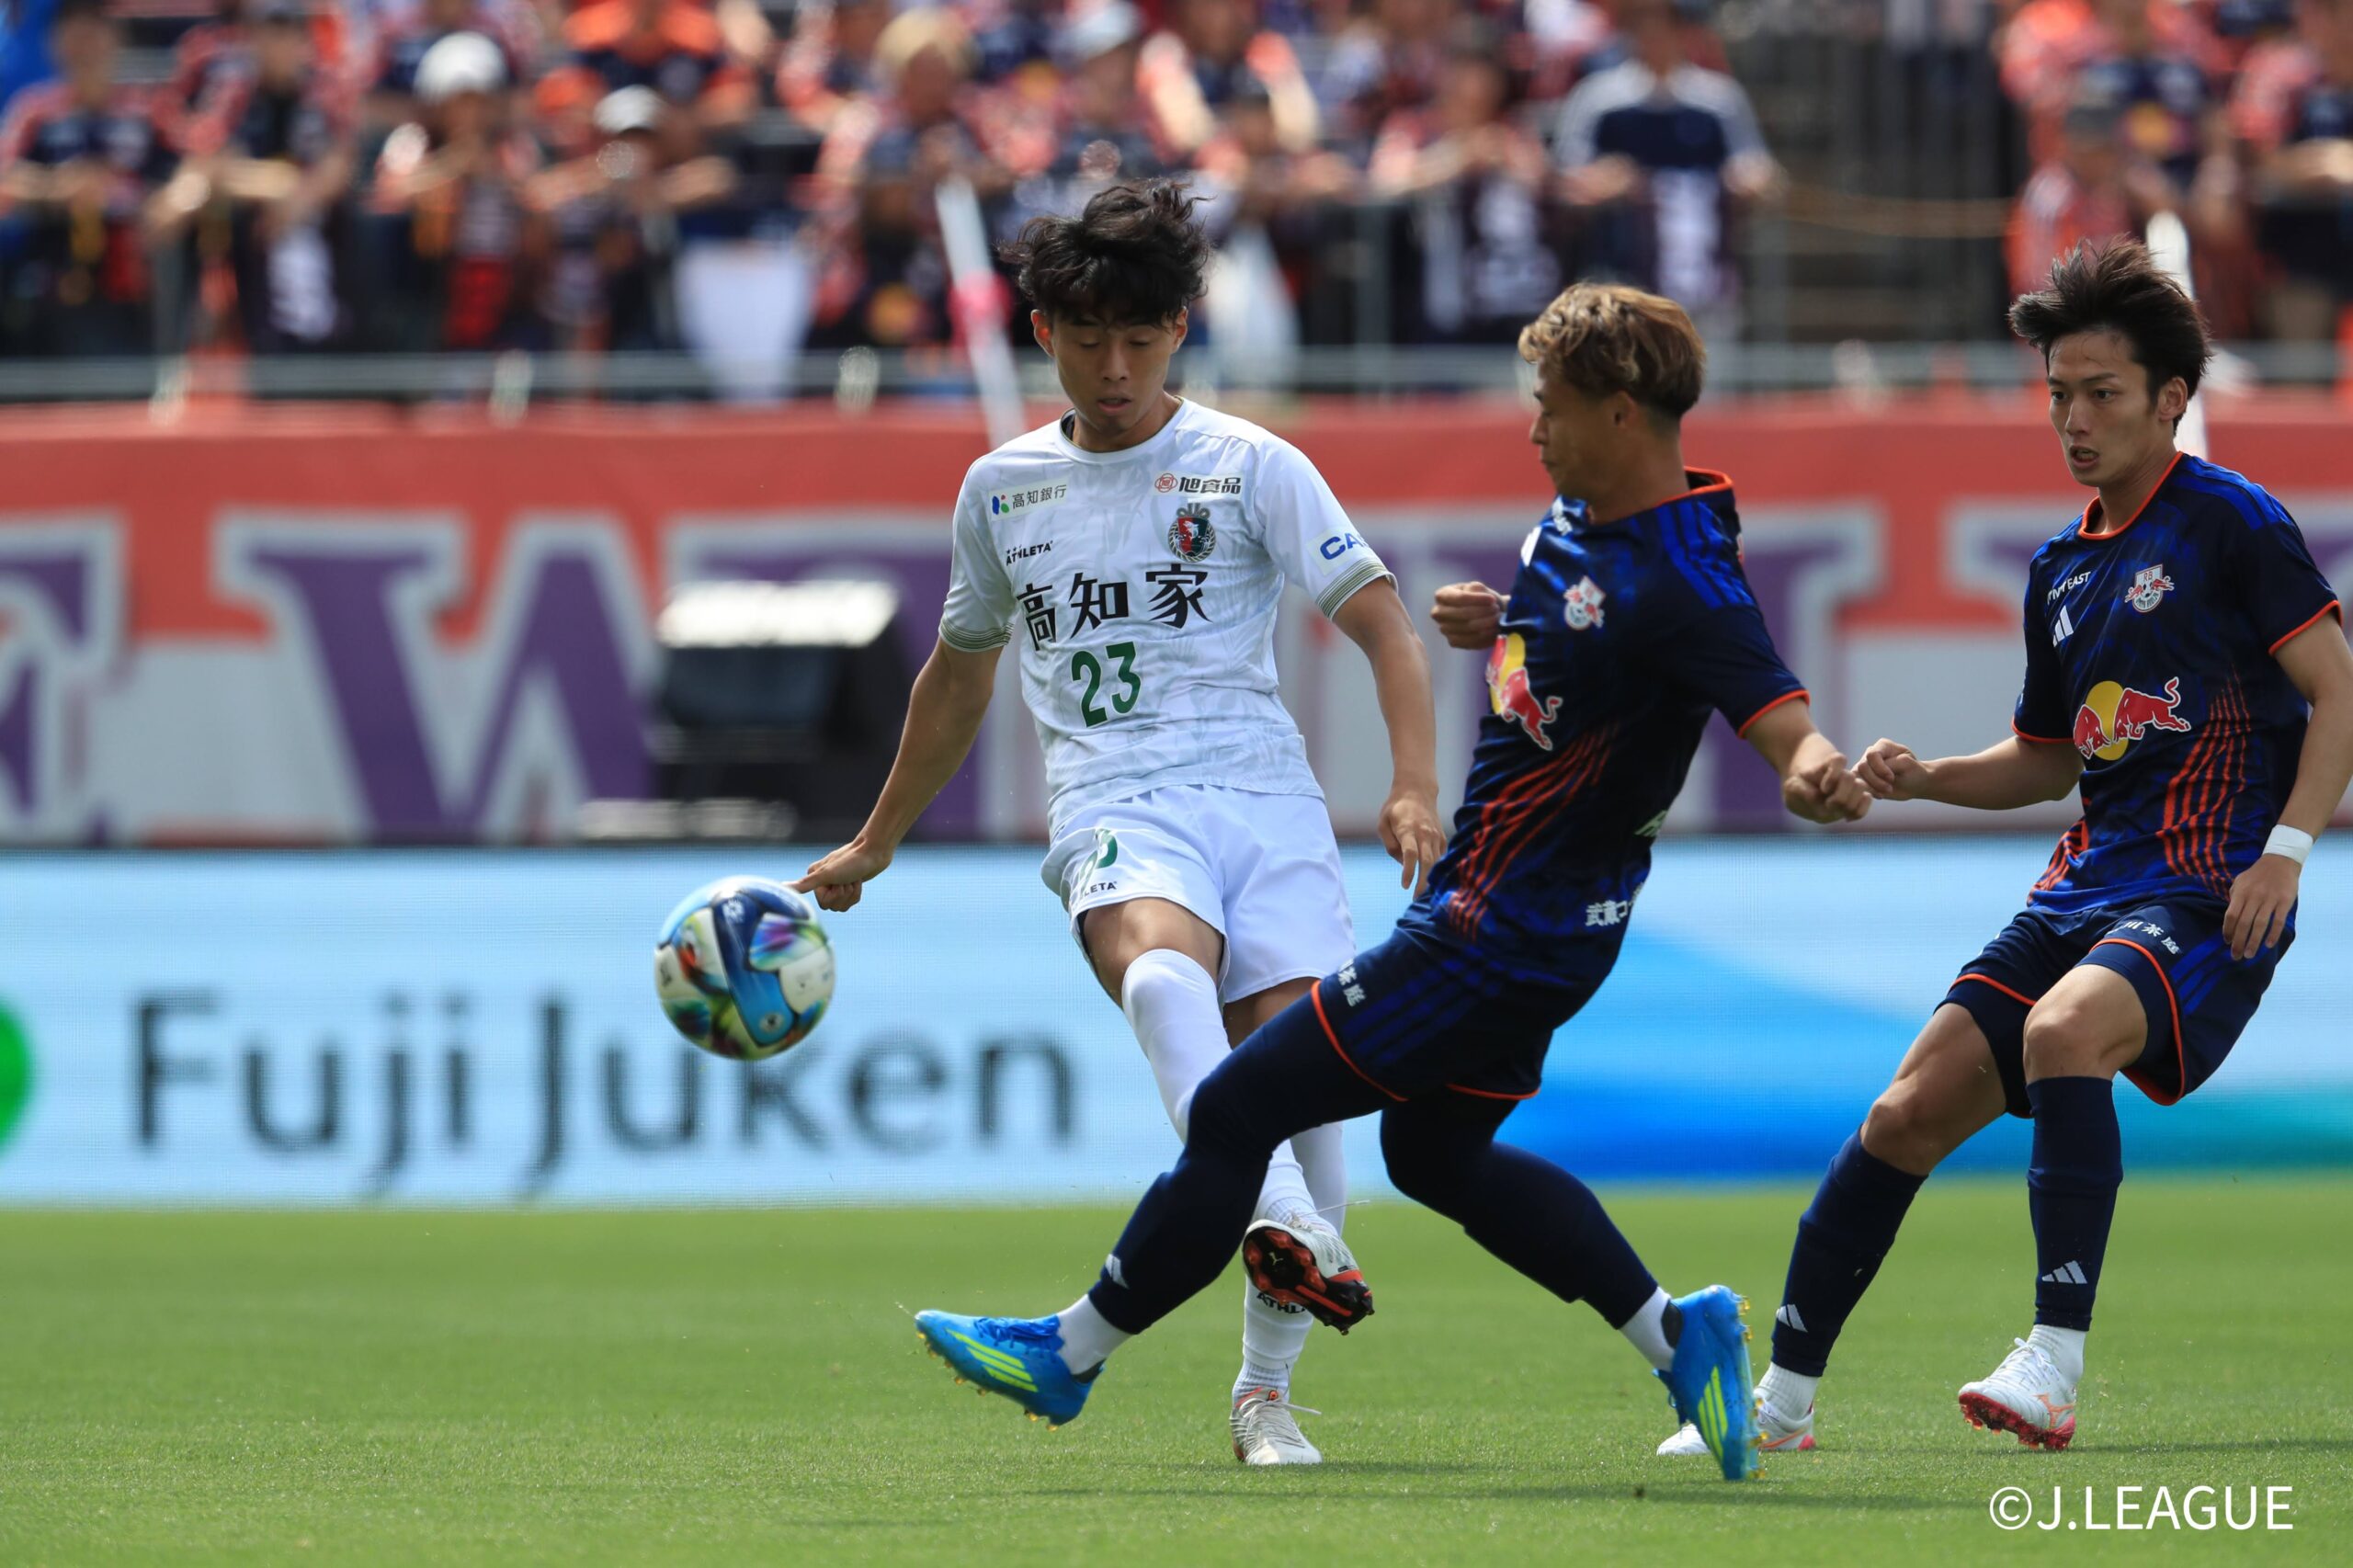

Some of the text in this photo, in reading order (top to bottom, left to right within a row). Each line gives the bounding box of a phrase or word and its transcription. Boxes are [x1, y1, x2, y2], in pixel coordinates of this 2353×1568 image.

[1012, 484, 1067, 509] 高知銀行
[1178, 476, 1241, 494] 旭食品
[1320, 533, 1366, 560] CA
[2067, 571, 2092, 589] EAST
[1017, 563, 1213, 652] 高知家
[1071, 641, 1142, 729] 23
[133, 989, 473, 1197] Fuji
[1256, 1291, 1305, 1314] ATHL
